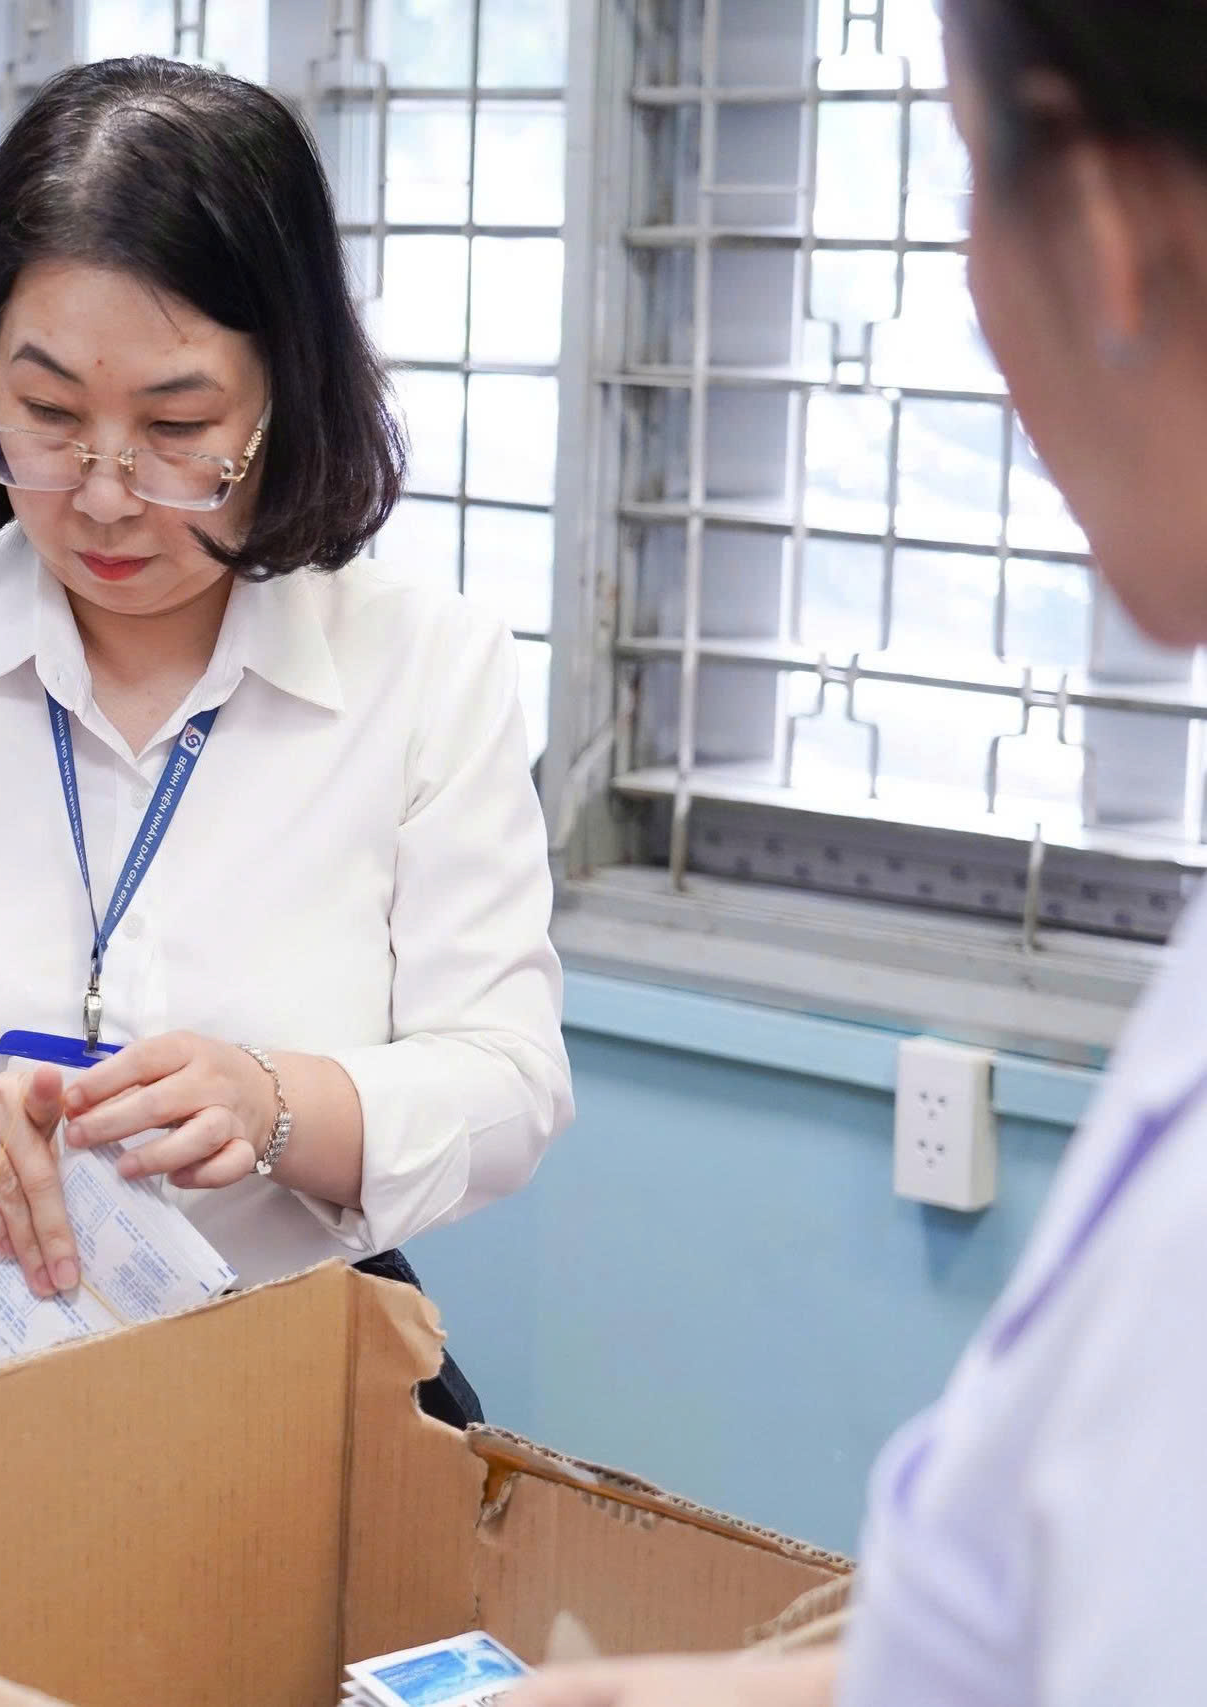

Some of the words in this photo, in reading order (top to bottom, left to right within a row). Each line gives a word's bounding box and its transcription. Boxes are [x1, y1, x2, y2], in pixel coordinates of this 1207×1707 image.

[170, 755, 187, 785] BỆNH
[160, 785, 175, 811] VIỆN
[145, 812, 163, 845] NHÂN
[134, 845, 148, 870] DÂN
[124, 869, 137, 889] GIA
[112, 889, 128, 918] ĐỊNH
